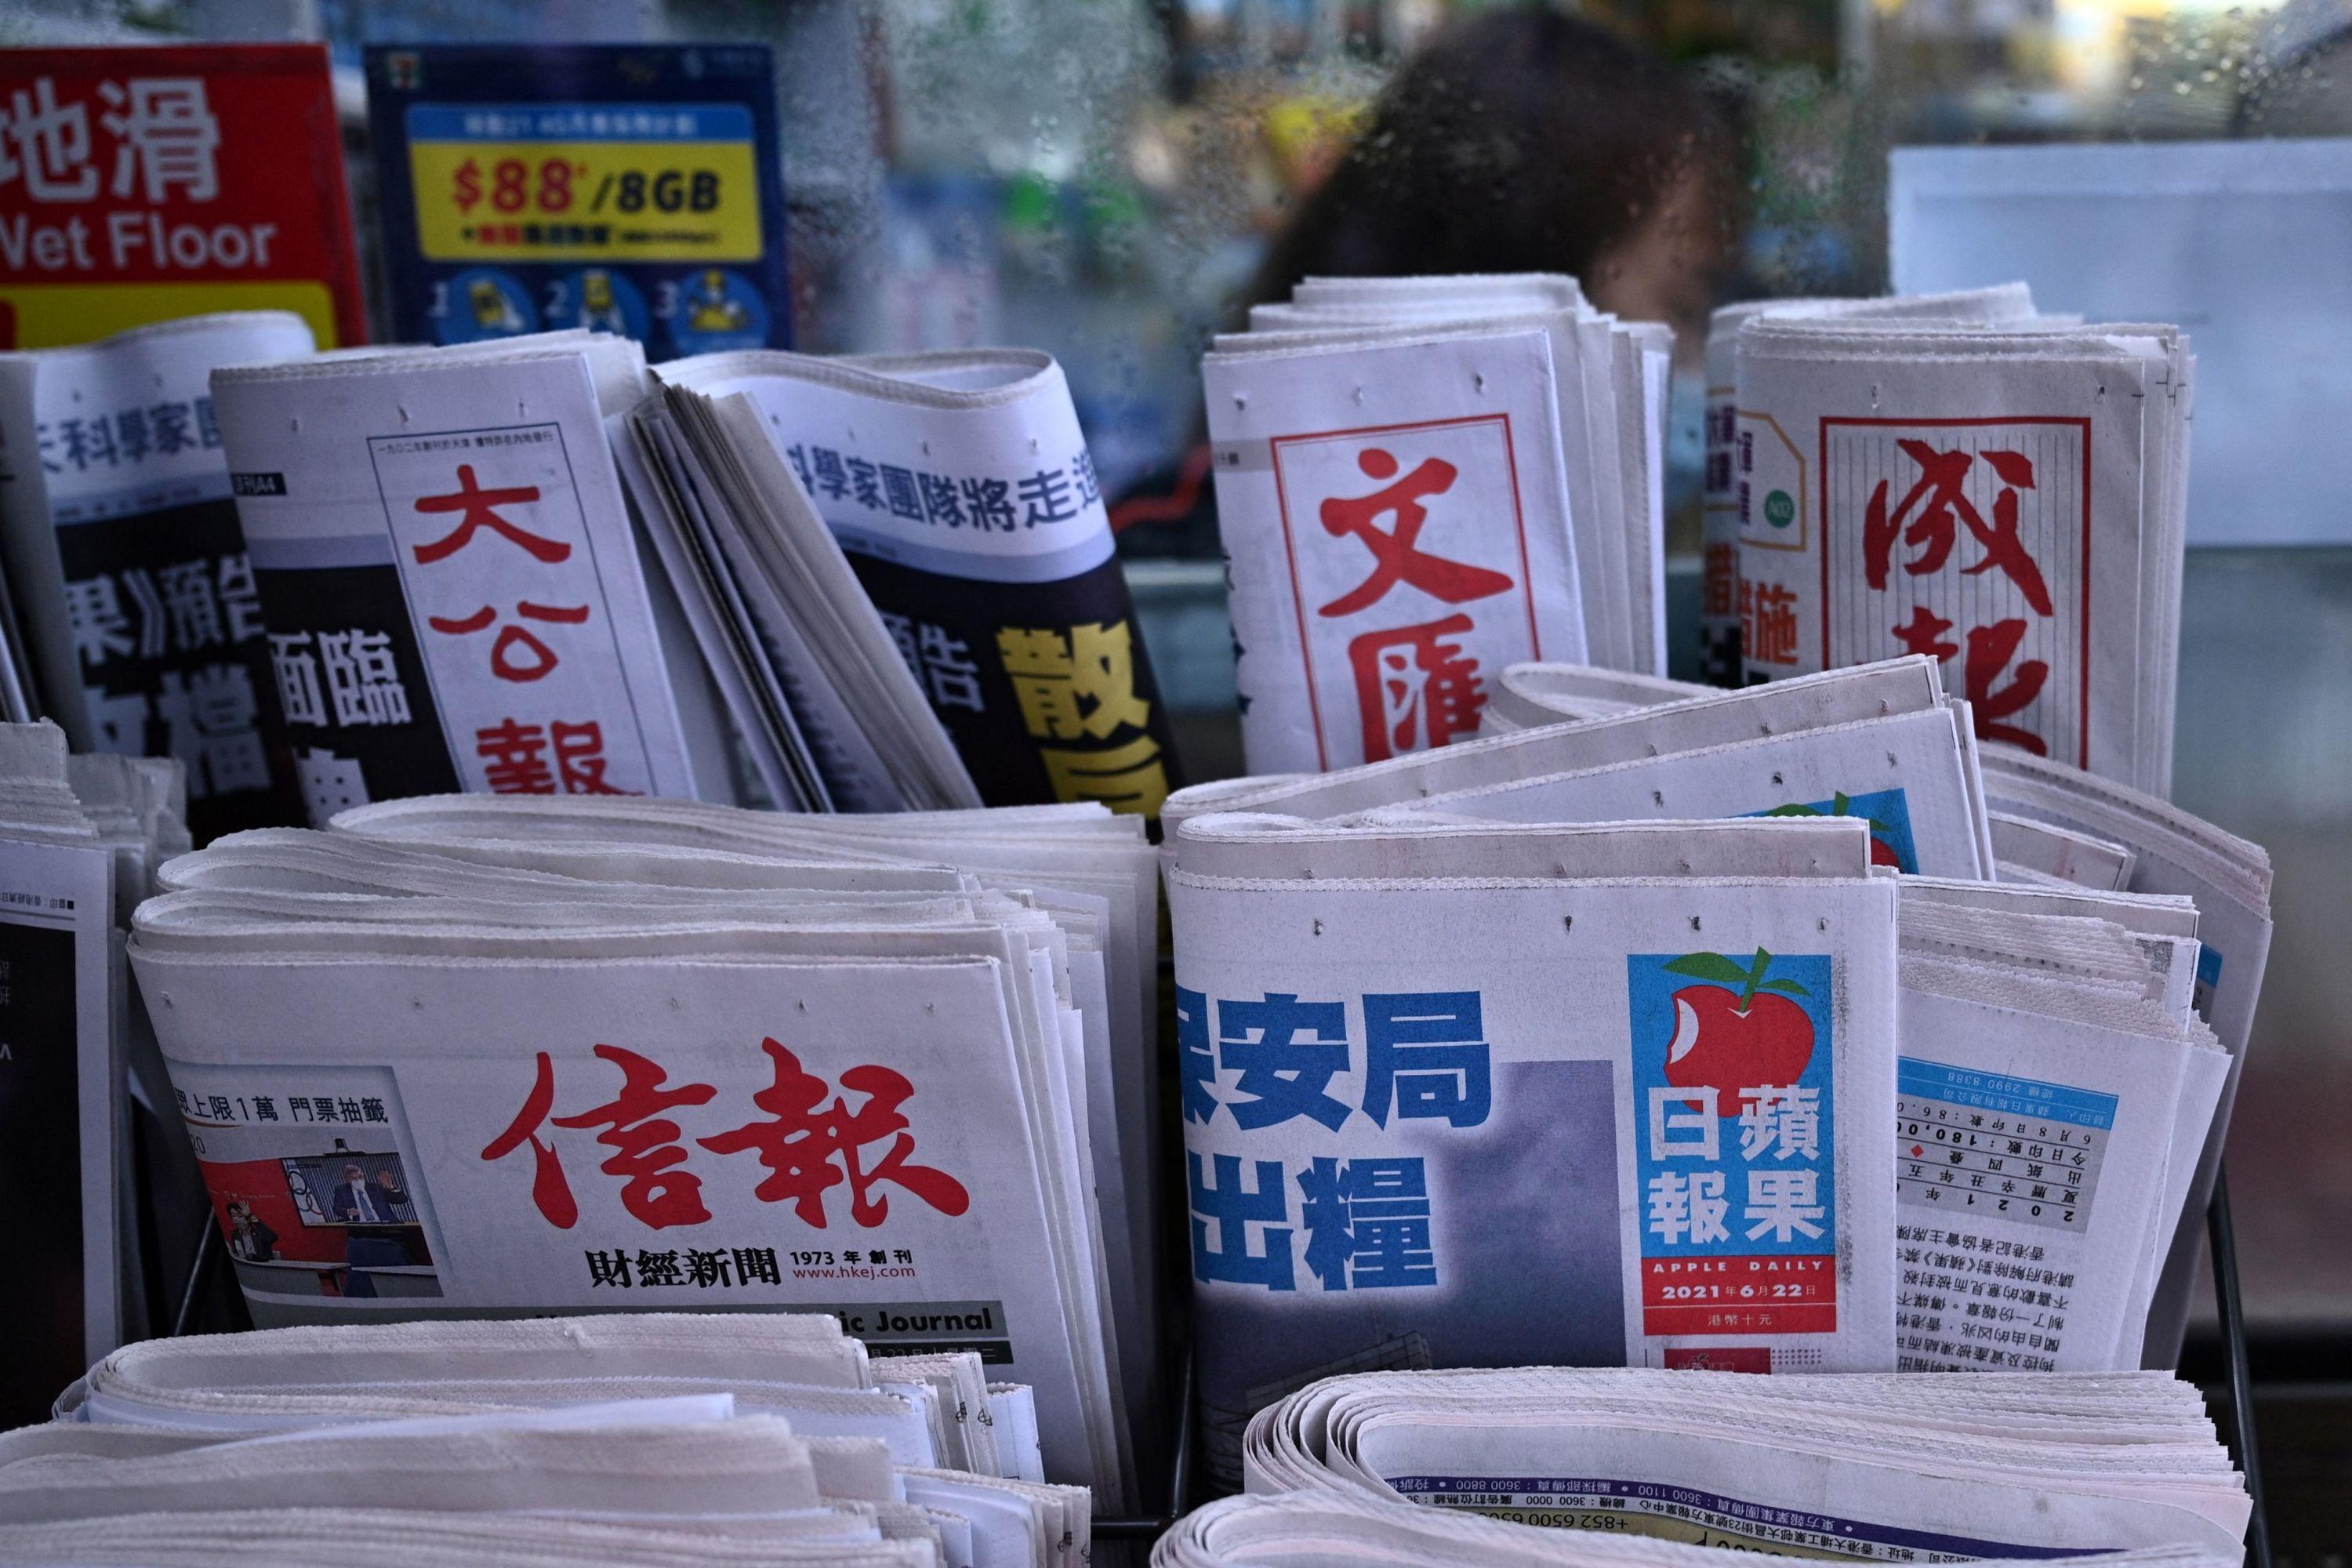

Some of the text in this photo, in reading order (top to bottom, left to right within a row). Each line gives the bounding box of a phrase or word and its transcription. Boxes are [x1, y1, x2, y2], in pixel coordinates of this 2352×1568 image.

[0, 76, 221, 205] 地滑
[107, 211, 278, 270] Floor
[416, 465, 644, 794] 大公報
[1947, 1072, 1980, 1085] 8388
[1987, 1079, 2020, 1092] 2990
[289, 1095, 389, 1124] 門票抽籤
[483, 1037, 970, 1230] 信報
[1647, 1083, 1730, 1245] 日報
[1737, 1083, 1826, 1243] 蘋果
[1895, 1182, 2074, 1222] 2021年
[1186, 1149, 1439, 1292] 出糧
[584, 1247, 782, 1289] 財經新聞
[793, 1265, 916, 1280] www.hkej.com
[1653, 1261, 1823, 1273] APPLE DAILY
[876, 1308, 993, 1333] Journal
[1707, 1312, 1773, 1326] 港幣十元
[1457, 1480, 1486, 1489] 8800
[1639, 1486, 1666, 1497] 1100
[1526, 1496, 1552, 1504] 0000
[1529, 1513, 1574, 1526] 6500
[1581, 1515, 1628, 1529] +852
